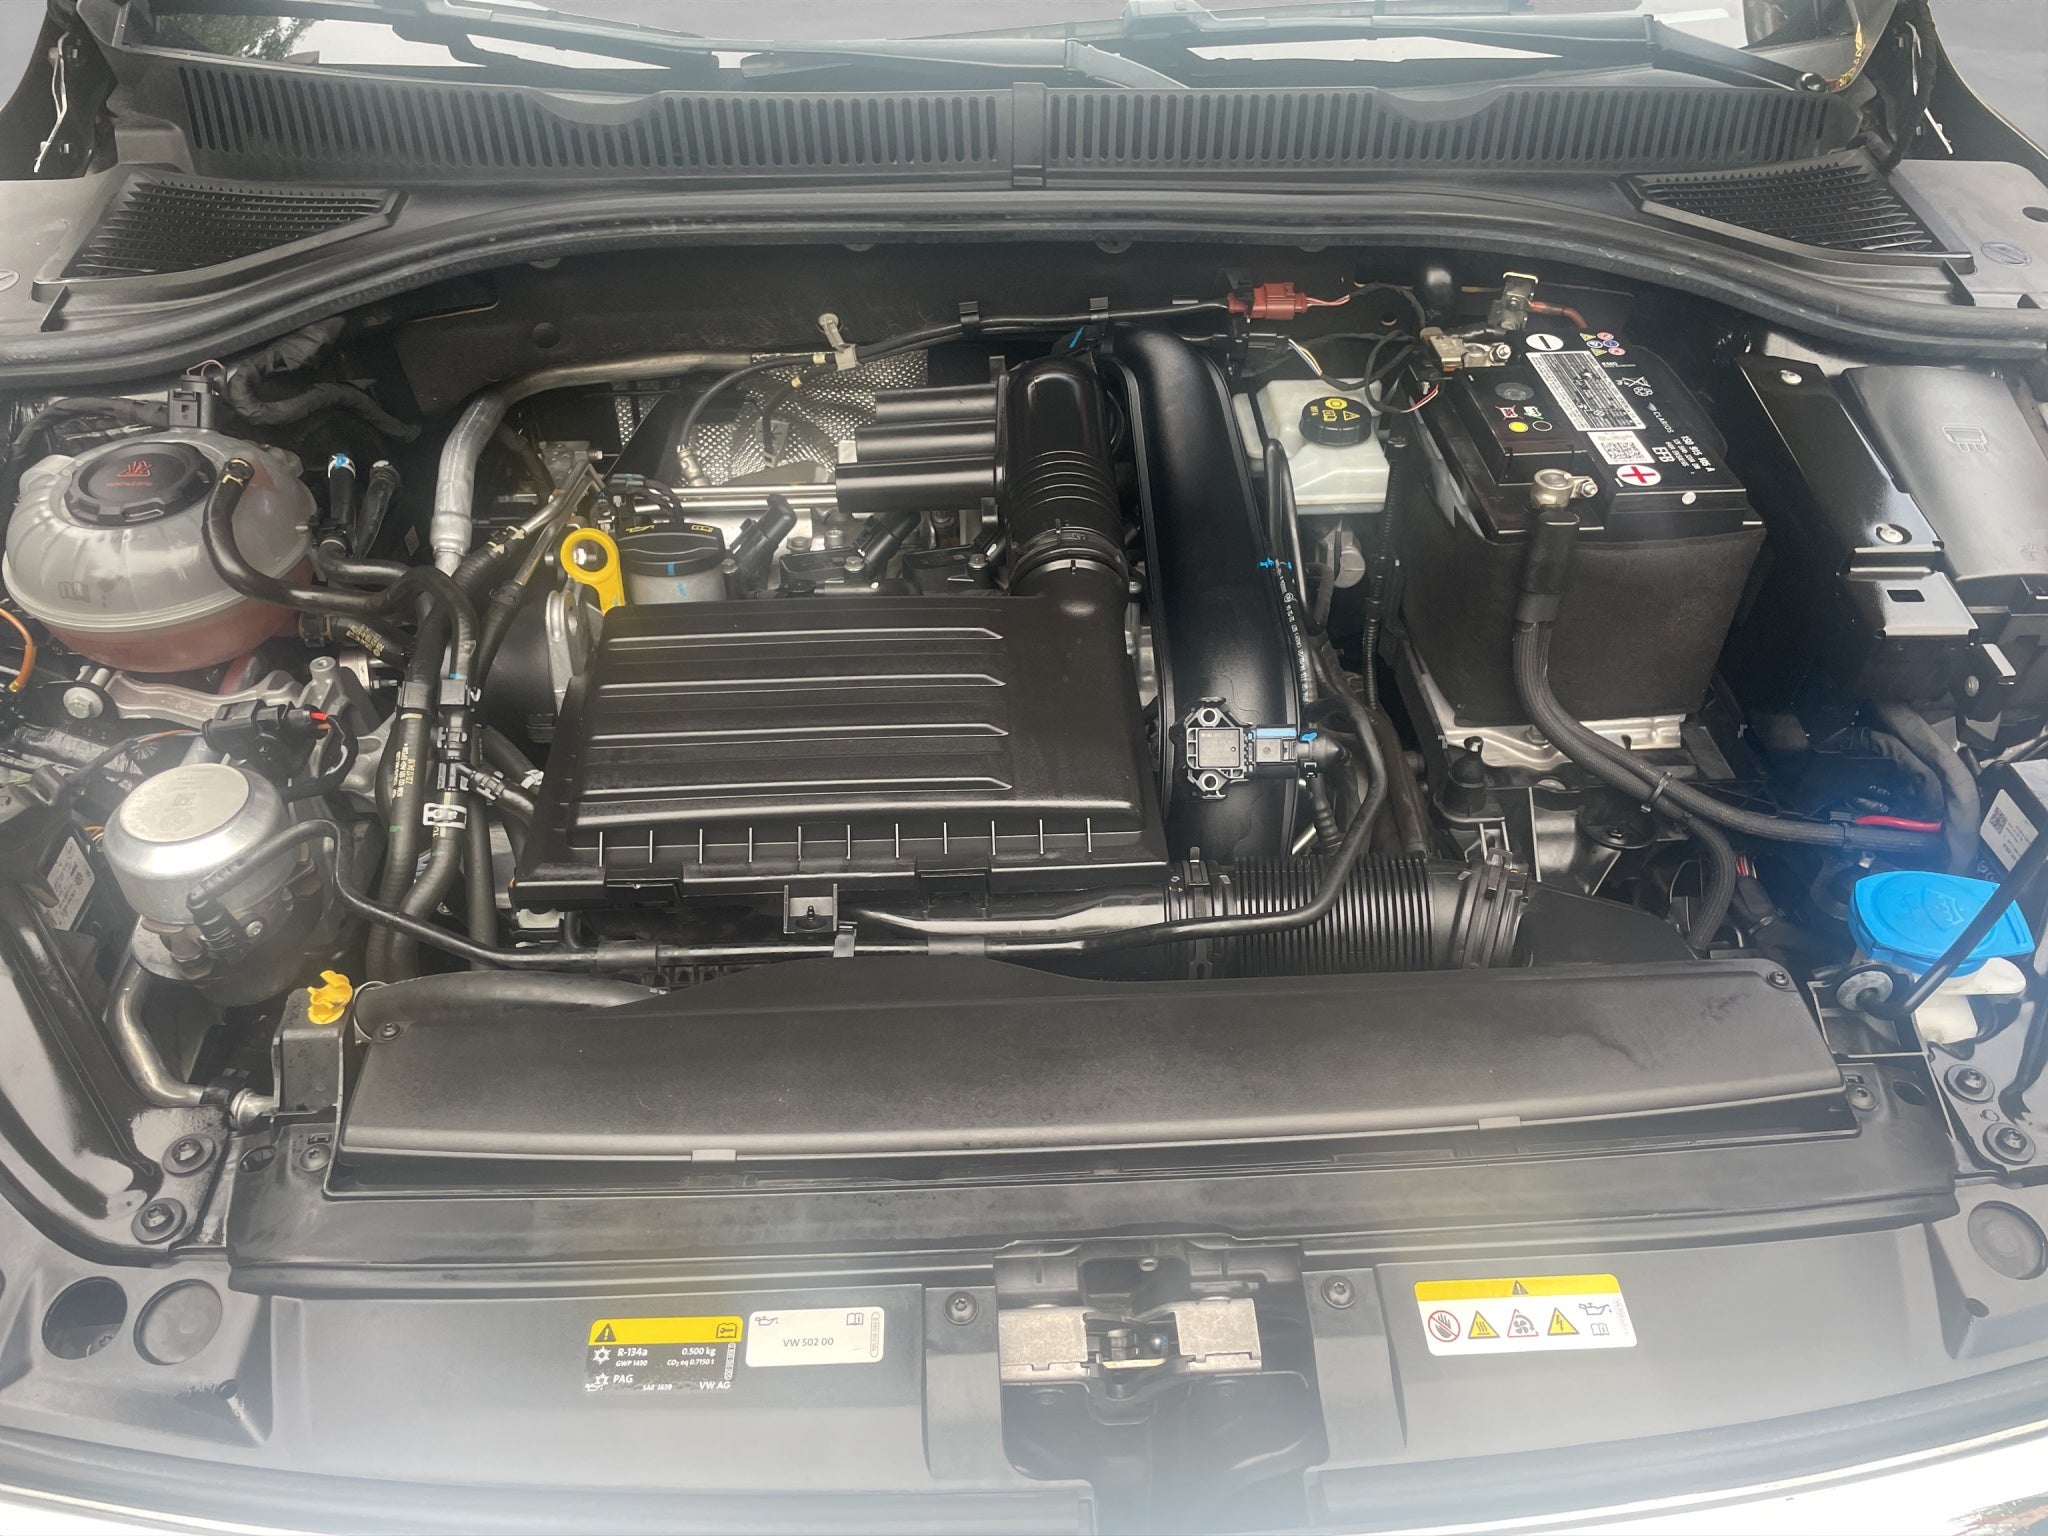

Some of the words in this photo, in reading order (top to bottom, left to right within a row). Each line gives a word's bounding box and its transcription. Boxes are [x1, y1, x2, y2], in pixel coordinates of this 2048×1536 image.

[1653, 411, 1675, 433] CLARIOS
[1651, 446, 1675, 462] EFB
[783, 1338, 800, 1347] VW
[802, 1337, 819, 1347] 502
[821, 1337, 834, 1346] 00
[617, 1347, 648, 1357] R-134a
[681, 1347, 704, 1355] 0.500
[705, 1347, 717, 1357] kg
[690, 1358, 710, 1366] 0.7150
[613, 1374, 634, 1384] PAG
[699, 1381, 715, 1390] VW
[716, 1381, 731, 1390] AG
